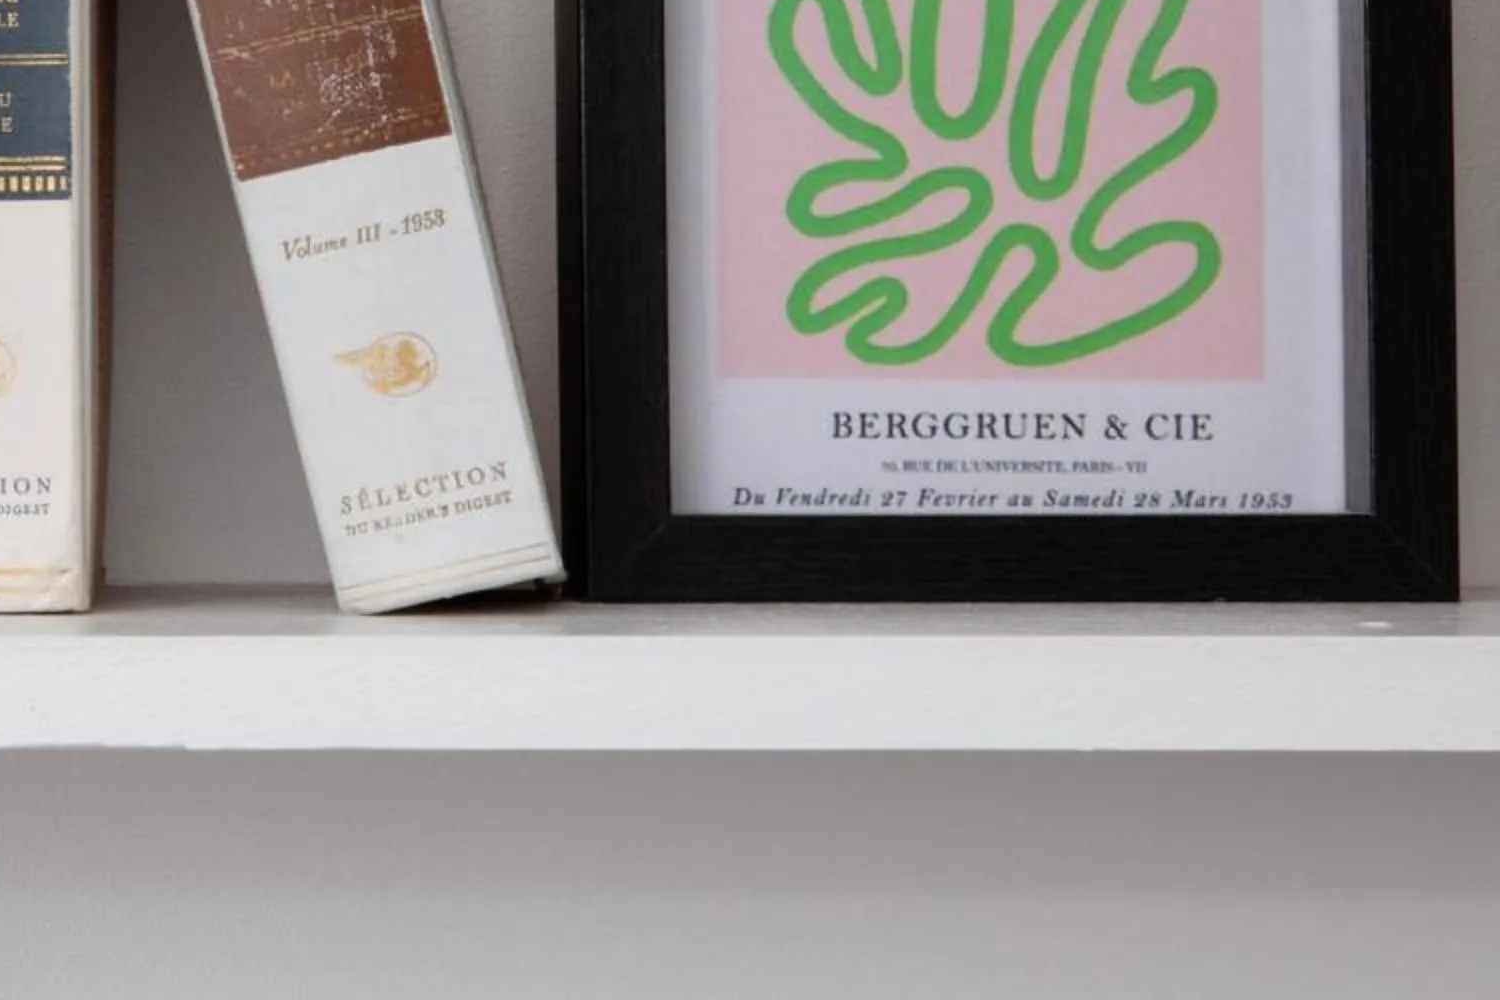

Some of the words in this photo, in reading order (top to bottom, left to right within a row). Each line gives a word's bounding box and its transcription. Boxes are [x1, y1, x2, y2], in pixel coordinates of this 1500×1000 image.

[281, 235, 347, 262] Volume
[356, 224, 381, 244] III
[402, 209, 445, 235] 1958
[832, 411, 1087, 441] BERGGRUEN
[1103, 413, 1128, 440] &
[1144, 413, 1214, 441] CIE
[340, 461, 508, 516] SÉLECTION
[733, 487, 765, 504] Du
[776, 487, 871, 506] Vendredi
[880, 489, 908, 507] 27
[1006, 493, 1033, 507] au
[1043, 489, 1125, 508] Samedi
[1133, 491, 1162, 508] 28
[1170, 490, 1228, 508] Mars
[1238, 492, 1293, 509] 1953
[345, 521, 367, 536] DU
[455, 490, 513, 515] DIGEST
